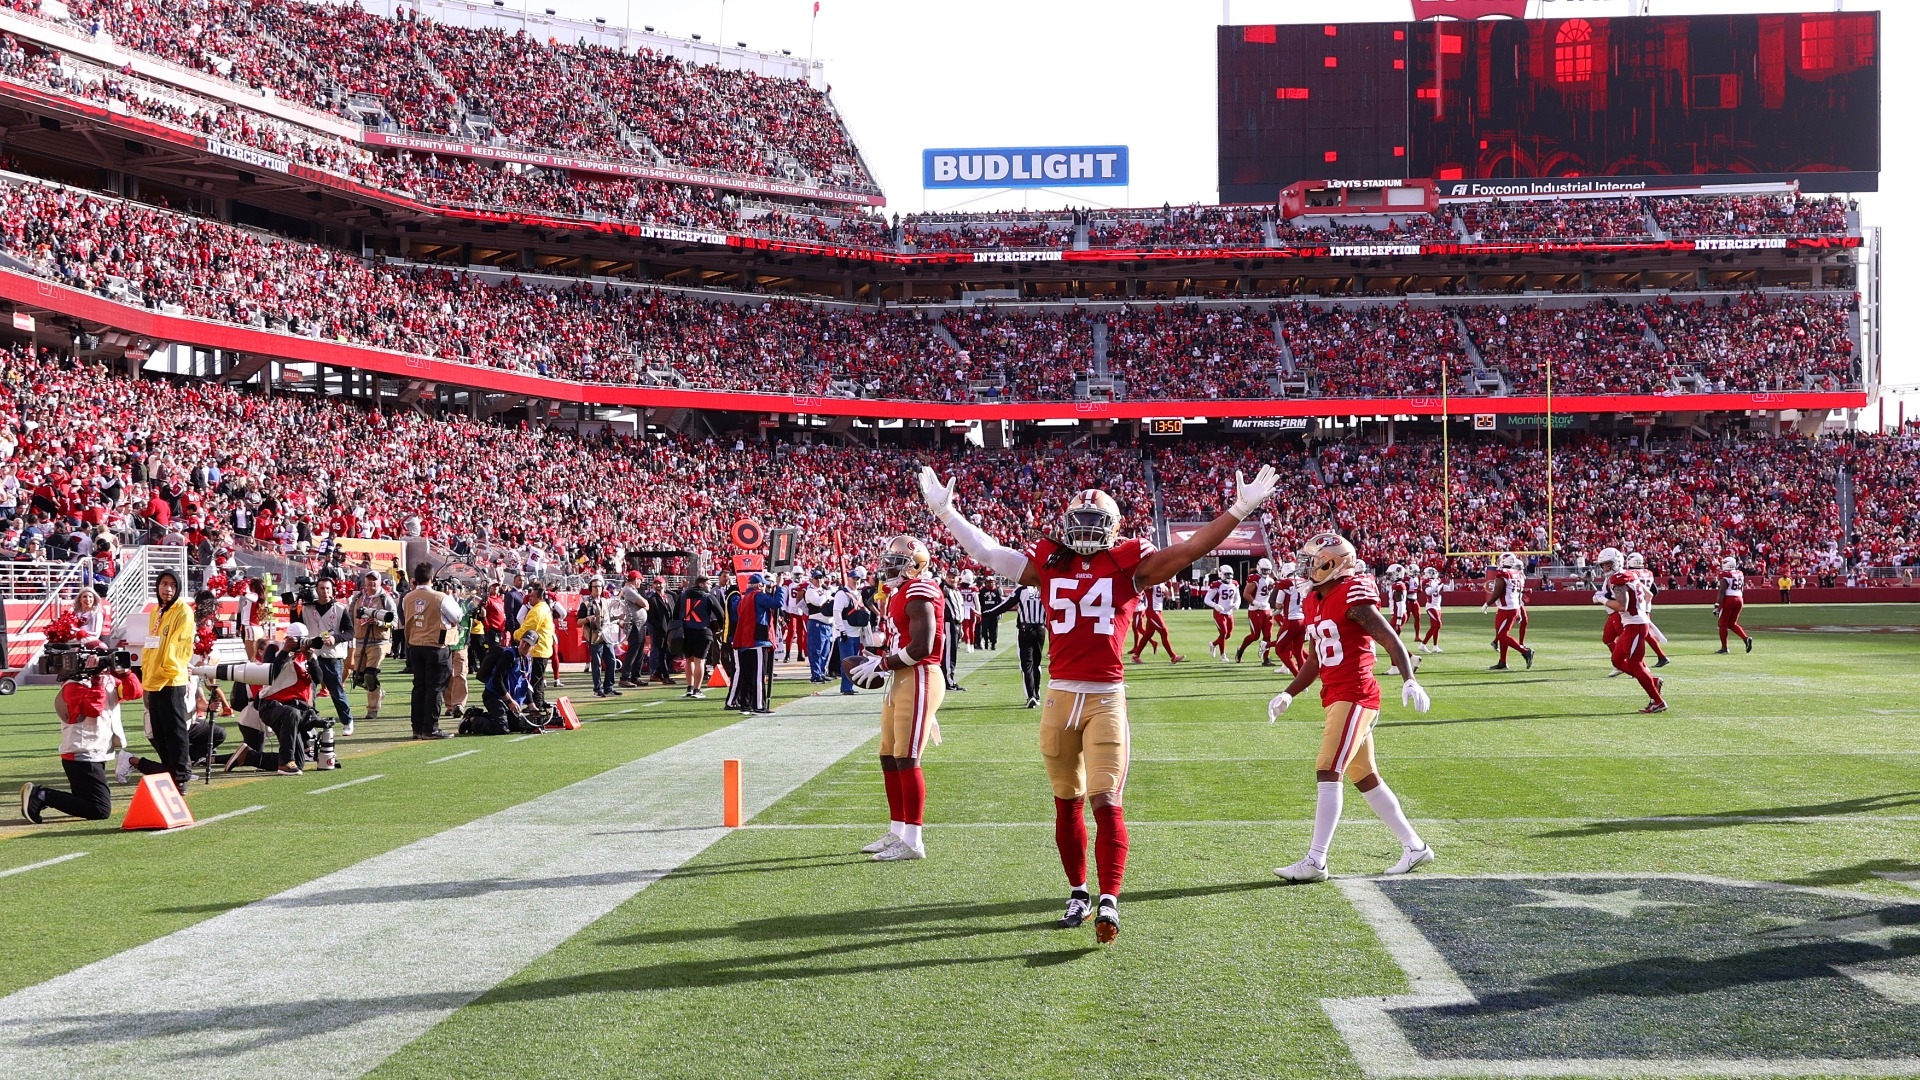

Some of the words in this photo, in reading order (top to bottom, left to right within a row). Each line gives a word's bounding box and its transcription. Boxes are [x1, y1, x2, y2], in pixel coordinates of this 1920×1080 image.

[207, 140, 290, 173] INTERCEPTION
[385, 136, 408, 145] FREE
[408, 138, 444, 150] XFINITY
[444, 142, 466, 153] WIFI.
[471, 146, 493, 157] NEED
[495, 149, 547, 163] ASSISTANCE?
[552, 157, 573, 166] TEXT
[573, 158, 617, 172] "SUPPORT"
[618, 165, 629, 173] TO
[630, 166, 649, 176] (573)
[650, 168, 685, 181] 549-HELP
[686, 173, 709, 184] (4357)
[716, 177, 747, 188] INCLUDE
[748, 181, 770, 191] ISSUE,
[770, 184, 817, 197] DESCRIPTION,
[818, 188, 833, 198] AND
[834, 191, 869, 203] LOCATION.
[1362, 179, 1402, 187] STADIUM
[1472, 183, 1528, 196] Foxconn
[1531, 181, 1592, 193] Industrial
[1595, 181, 1646, 191] Internet
[640, 226, 727, 245] INTERCEPTION
[1329, 245, 1420, 256] INTERCEPTION
[1695, 239, 1786, 250] INTERCEPTION
[973, 251, 1062, 262] INTERCEPTION
[1154, 421, 1181, 432] 13:50
[1477, 416, 1493, 427] 25
[1221, 589, 1235, 600] 52
[685, 598, 702, 622] K
[1049, 577, 1116, 636] 54
[154, 779, 188, 821] G
